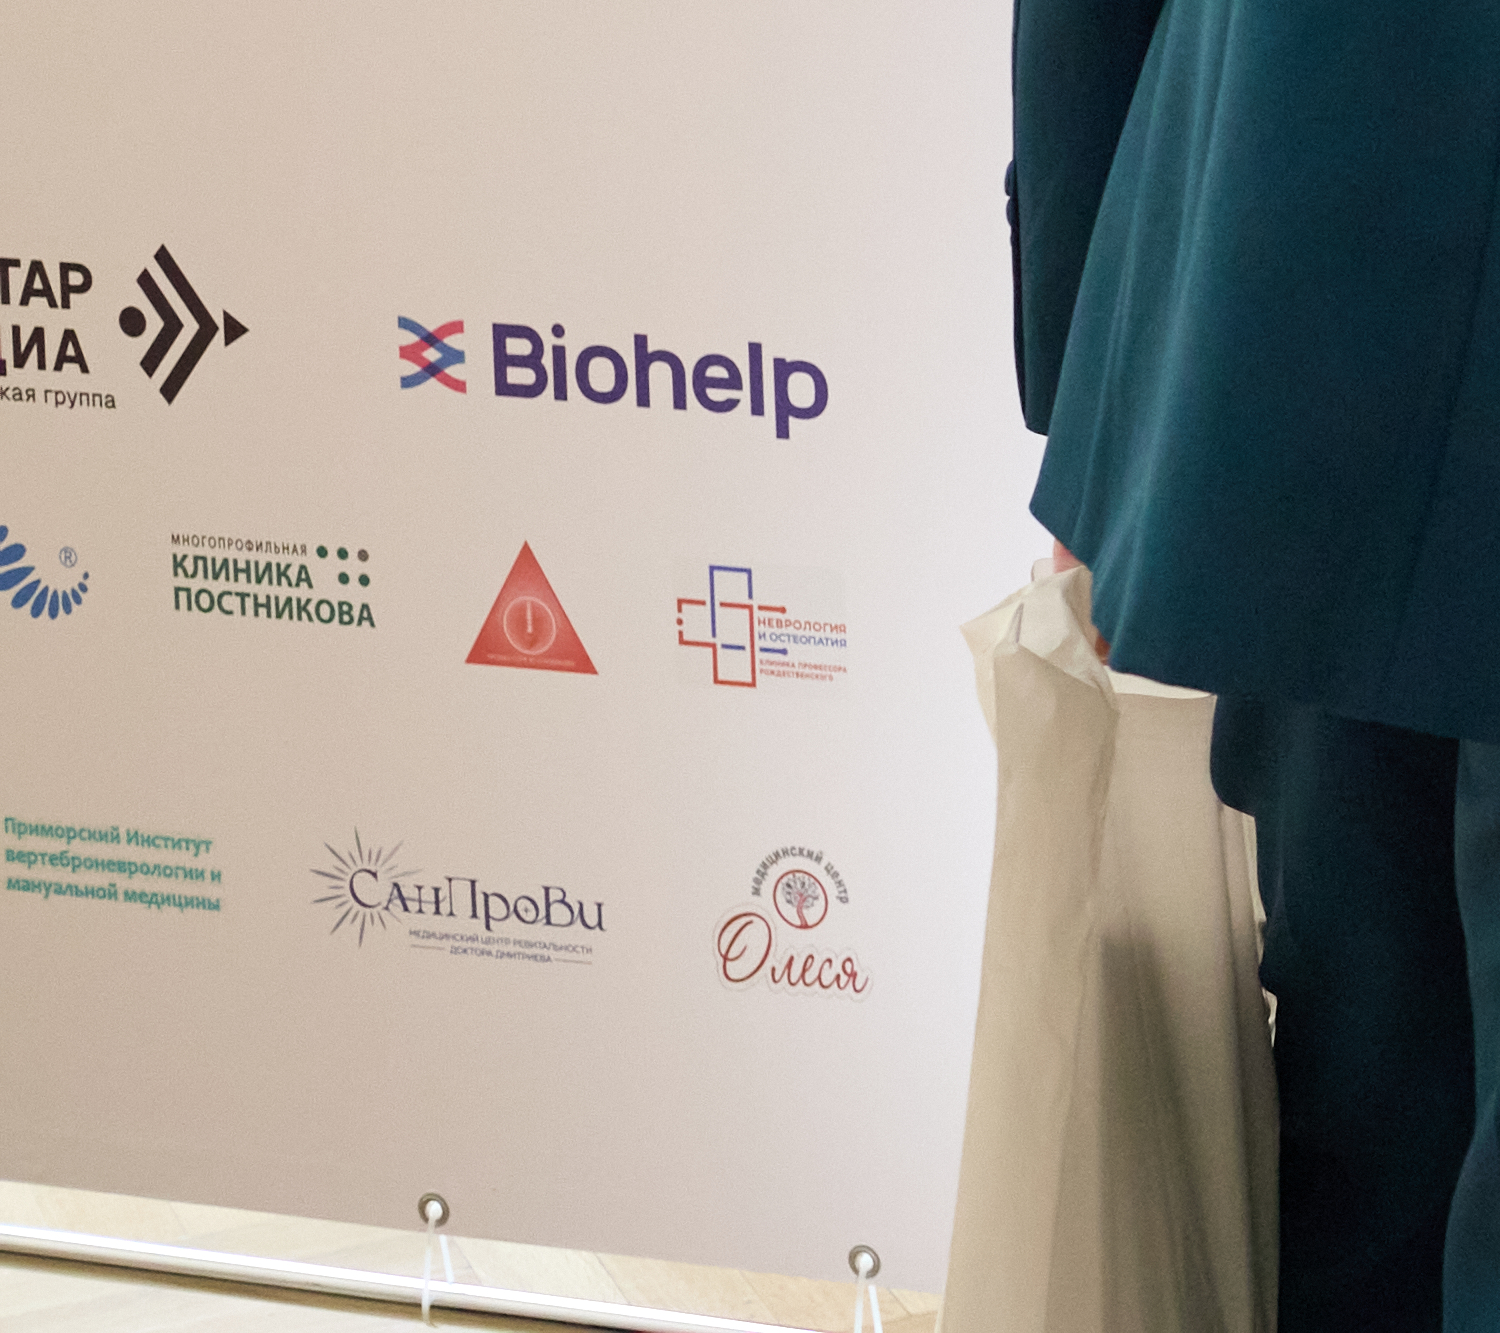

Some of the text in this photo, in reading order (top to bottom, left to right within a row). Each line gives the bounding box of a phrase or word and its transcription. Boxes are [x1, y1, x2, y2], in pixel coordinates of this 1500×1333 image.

[0, 324, 90, 376] ИА
[492, 322, 829, 440] Biohelp
[44, 389, 117, 410] группа
[171, 533, 307, 556] МНОГОПРОФИЛЬНАЯ
[172, 553, 313, 590] КЛИНИКА
[173, 586, 376, 628] ПОСТНИКОВА
[757, 616, 847, 635] НЕВРОЛОГИЯ
[769, 632, 847, 648] ОСТЕОПАТИЯ
[4, 817, 213, 858] Приморский Институт
[5, 848, 205, 882] вертеброневрологии
[7, 877, 221, 913] мануальной медицины
[717, 911, 869, 994] Олеся
